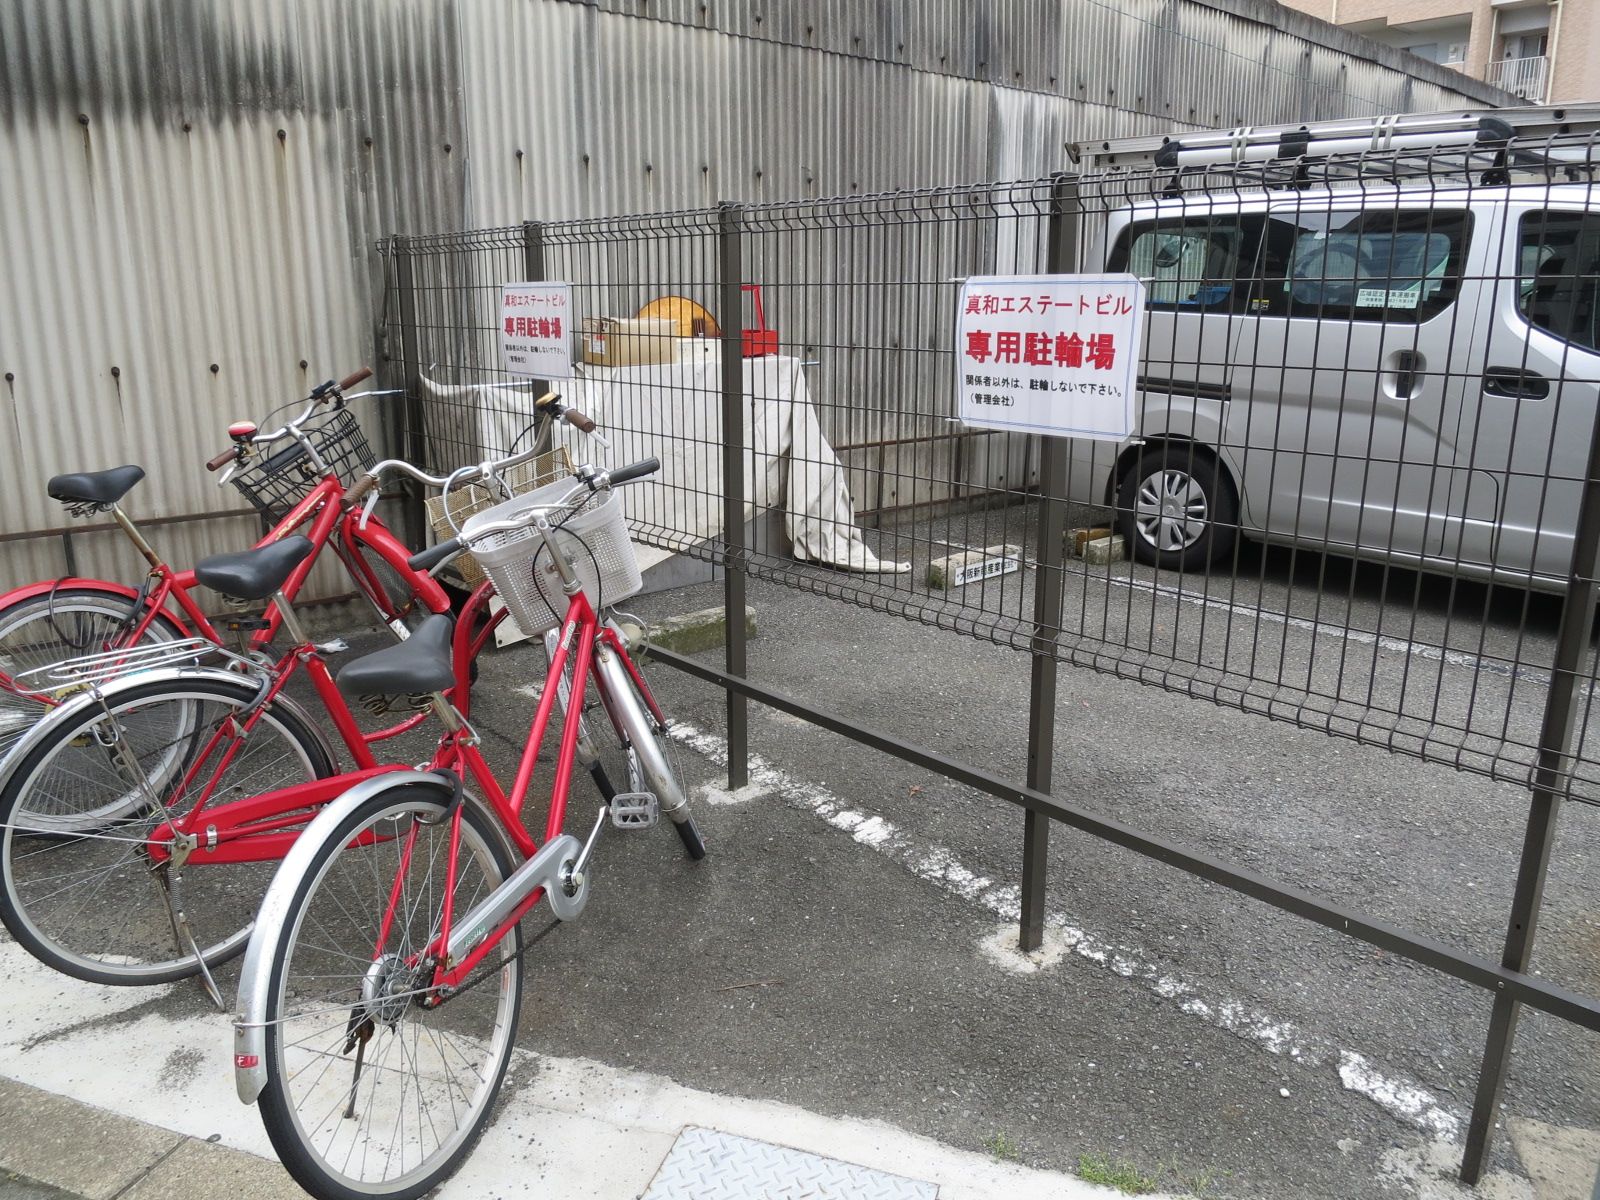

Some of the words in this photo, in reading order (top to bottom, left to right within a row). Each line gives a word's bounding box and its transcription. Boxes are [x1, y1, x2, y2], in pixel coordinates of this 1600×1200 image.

[504, 294, 566, 307] 真和エステートビル
[965, 294, 1133, 316] 真和エステートビル
[504, 316, 562, 340] 専用駐輪場
[965, 329, 1116, 370] 専用駐輪場
[965, 374, 1122, 398] 関係者以外は、駐輪しないで下さい。
